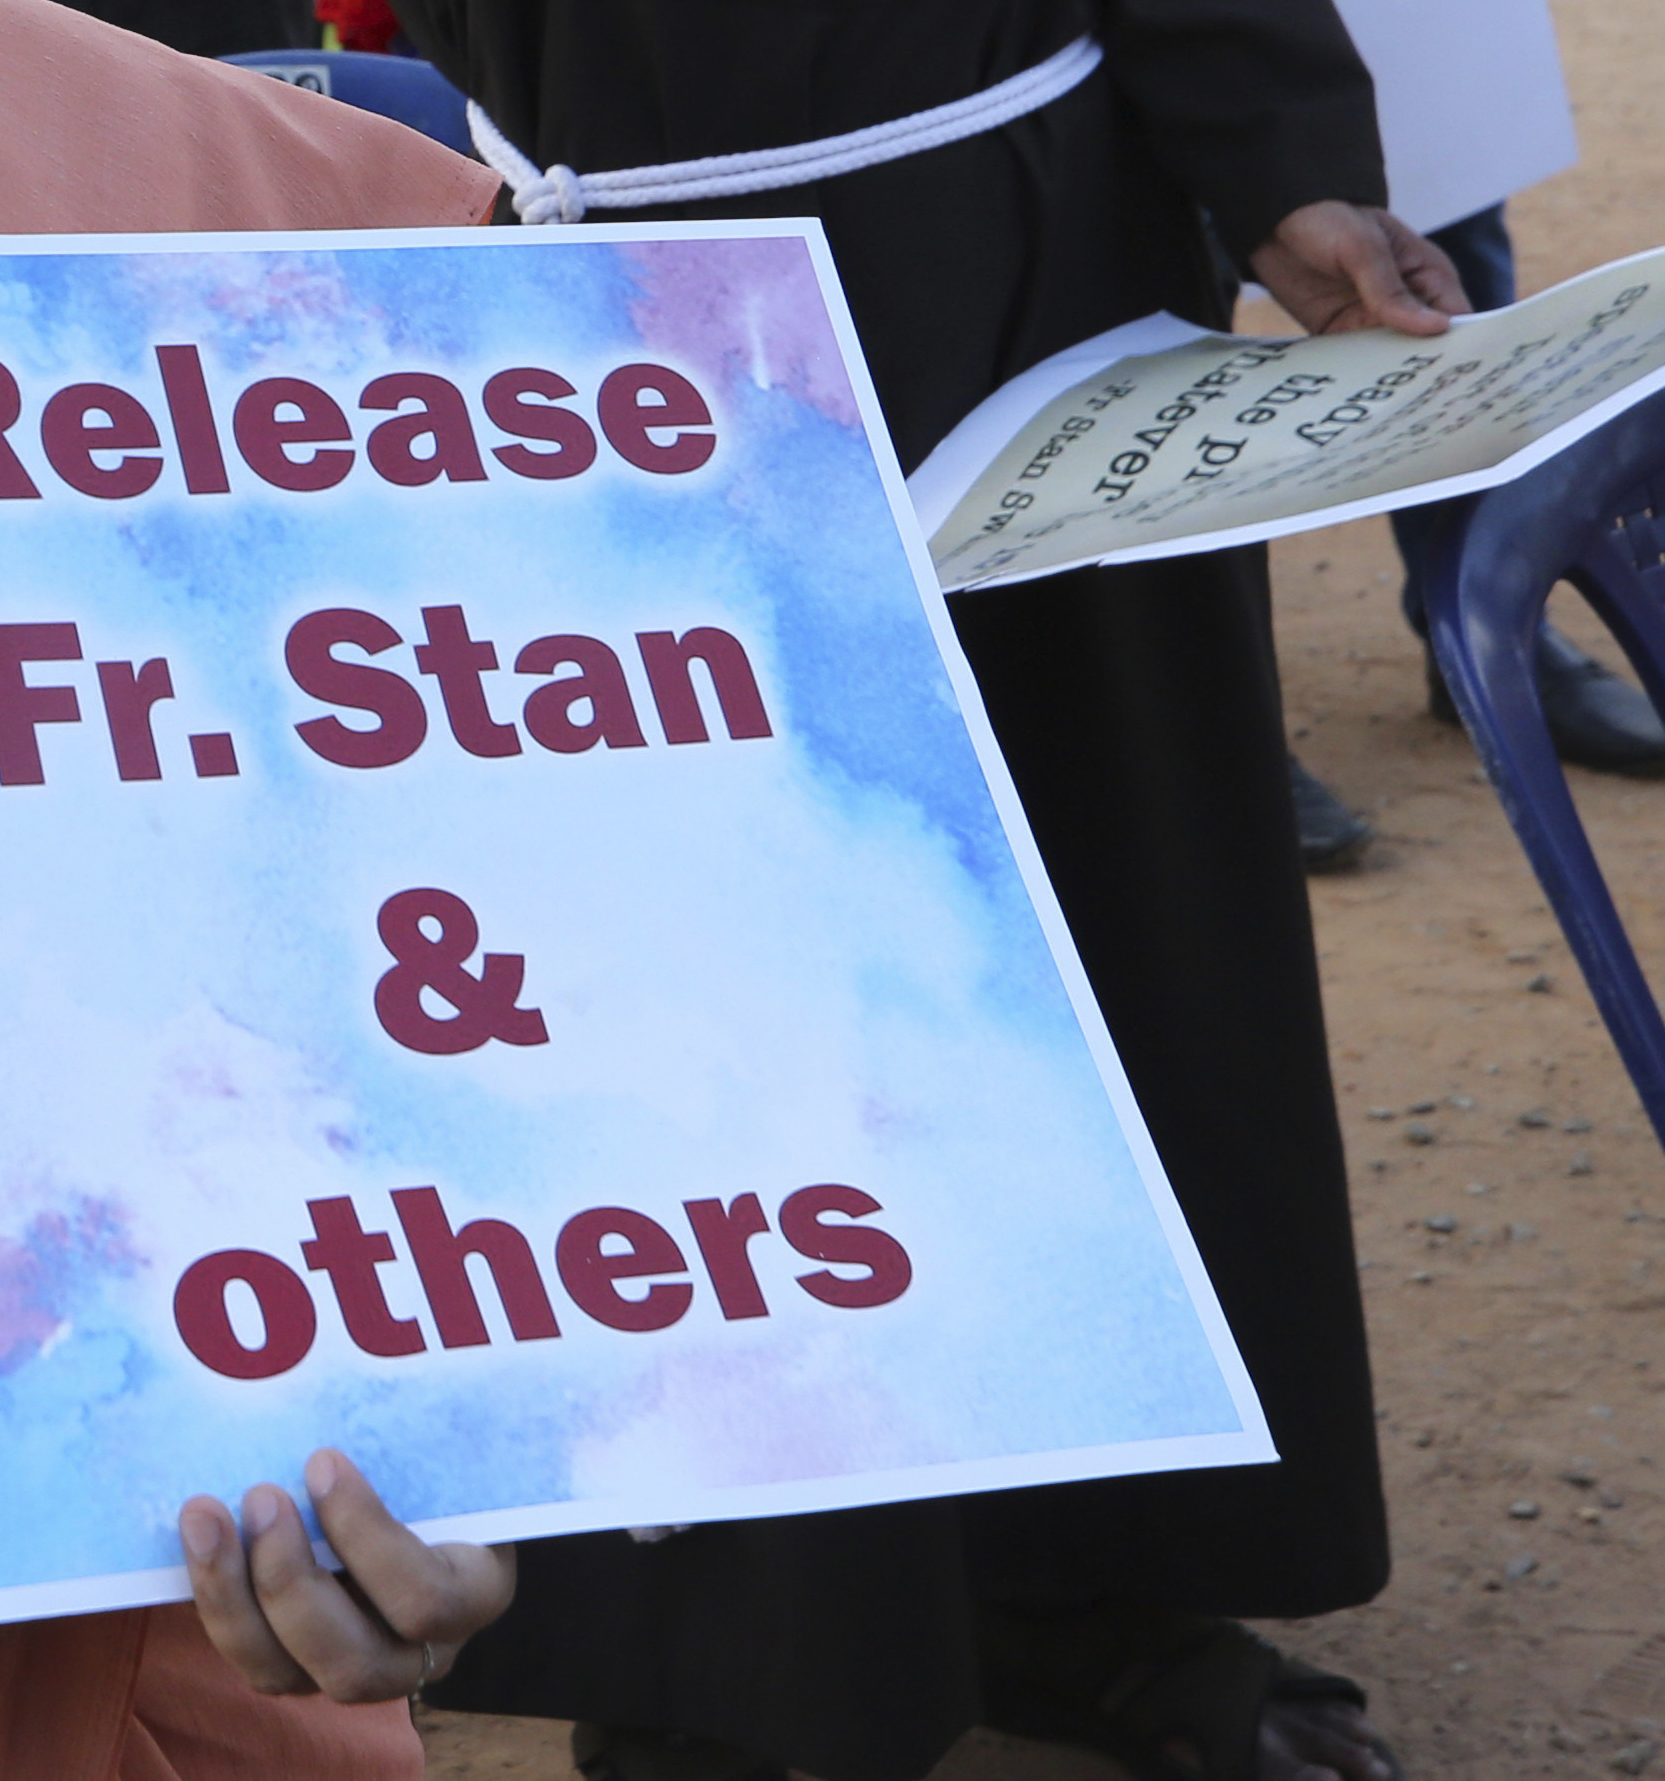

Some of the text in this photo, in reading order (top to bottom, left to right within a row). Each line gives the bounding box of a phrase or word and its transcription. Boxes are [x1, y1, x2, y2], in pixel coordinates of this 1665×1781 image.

[1019, 415, 1096, 482] Stan
[1235, 373, 1336, 426] the
[1295, 352, 1443, 447] ready
[285, 605, 771, 768] Stan
[374, 887, 549, 1055] &
[174, 1184, 912, 1380] others
